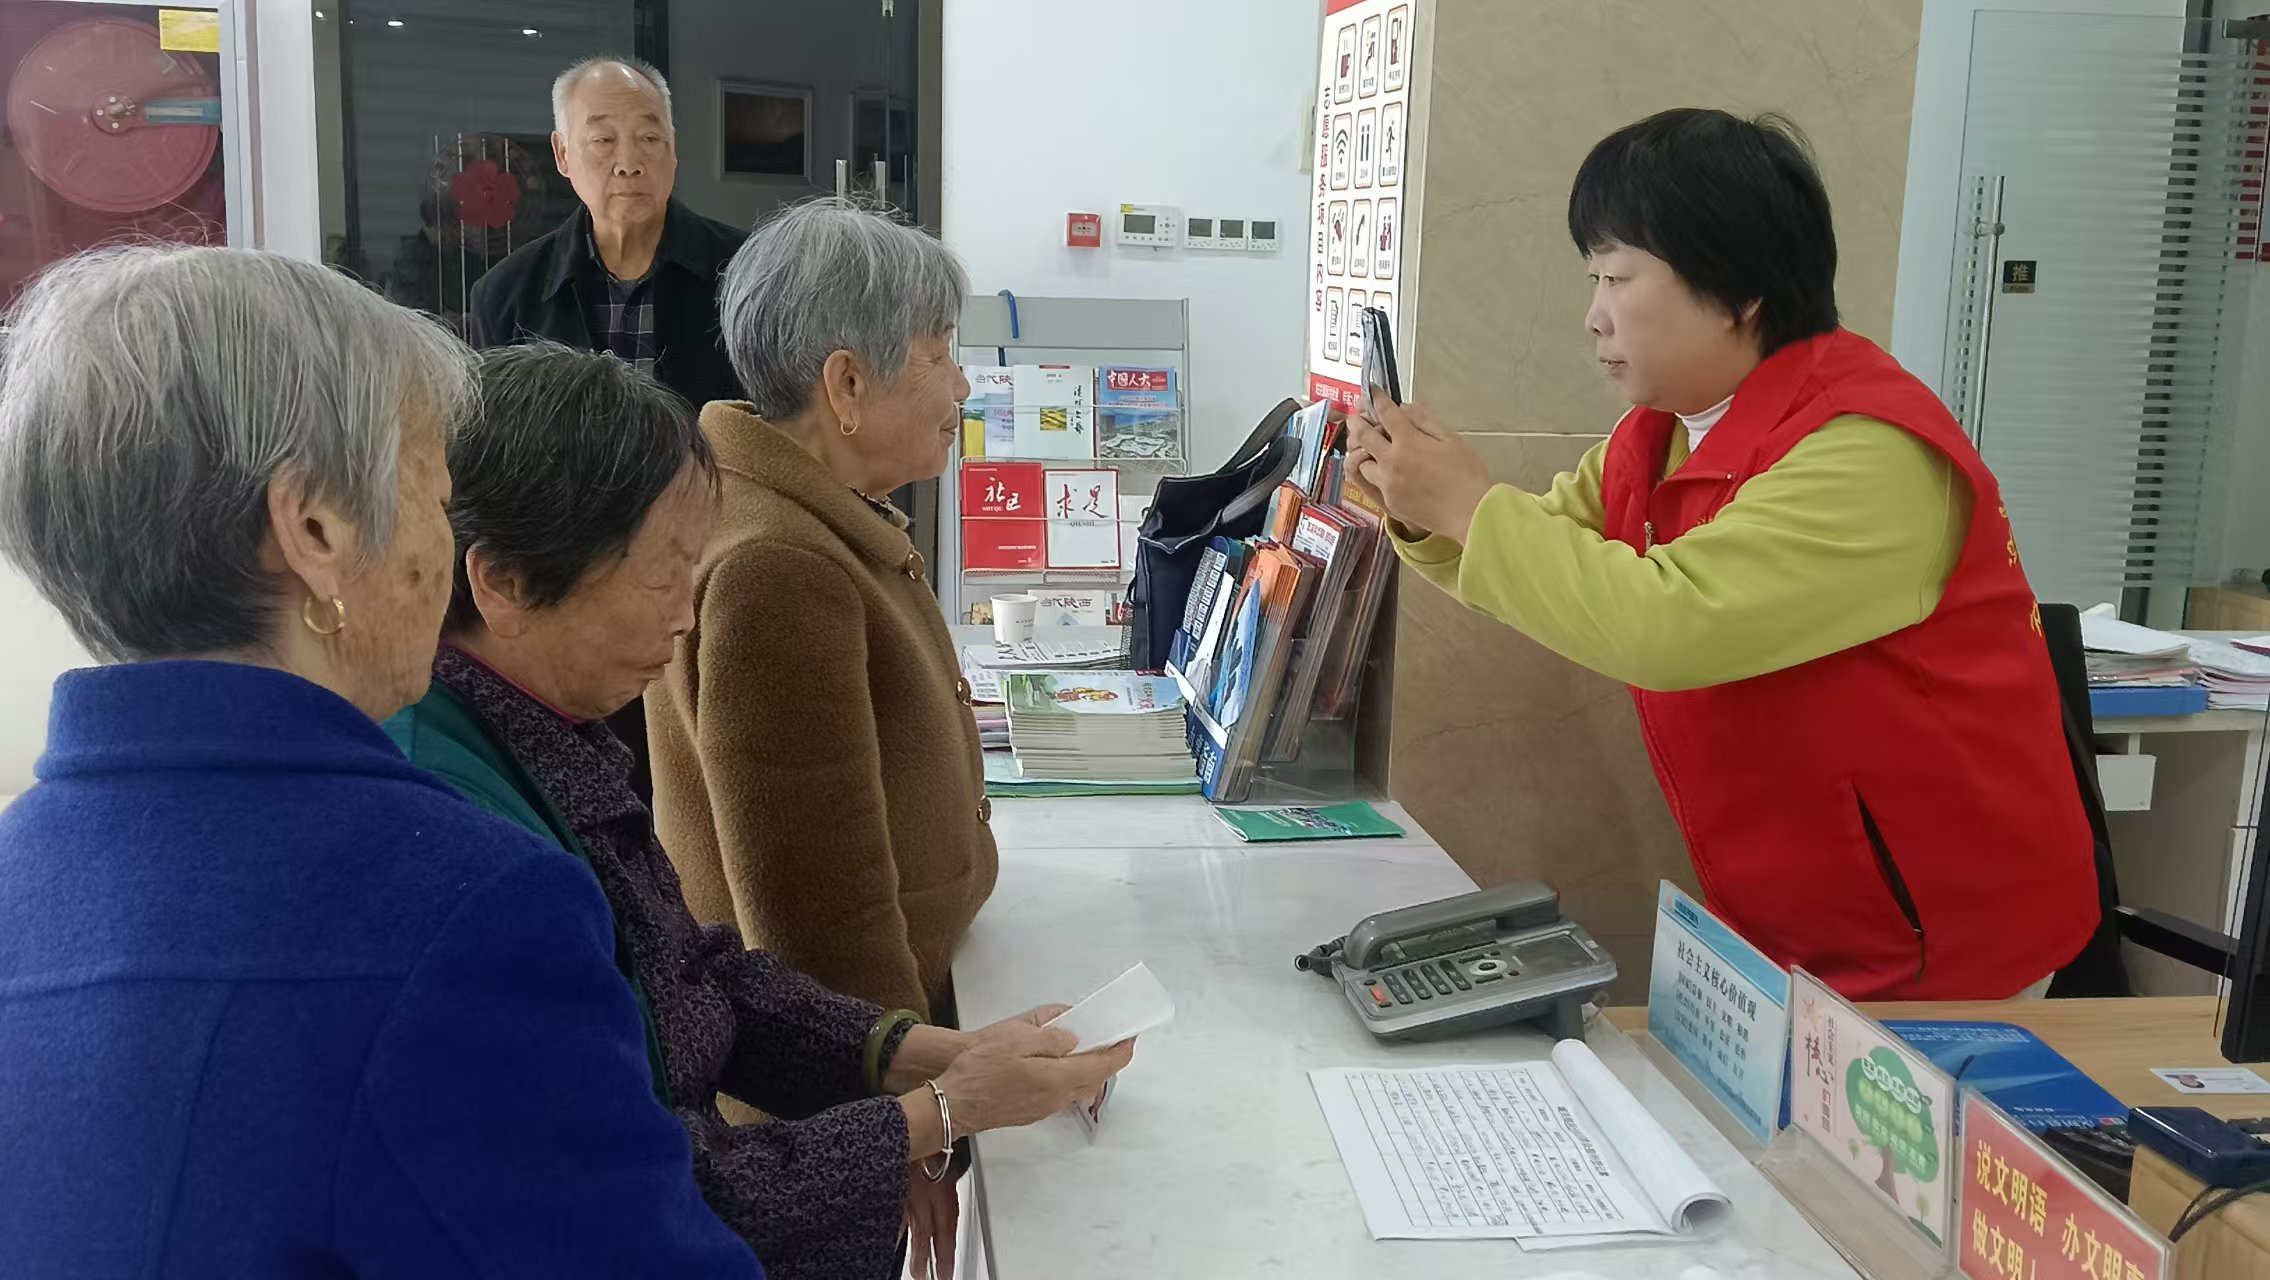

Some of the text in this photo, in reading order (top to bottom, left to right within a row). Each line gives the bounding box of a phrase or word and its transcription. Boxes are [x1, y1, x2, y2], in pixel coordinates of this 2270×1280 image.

[2012, 263, 2029, 282] 推
[1107, 369, 1151, 389] 中国人大
[984, 476, 1022, 511] 社区
[1056, 484, 1109, 519] 求是
[1040, 597, 1093, 609] 当代陕西
[1677, 938, 1757, 1022] 社会主义核心价值观
[1976, 1139, 2048, 1237] 说文明语
